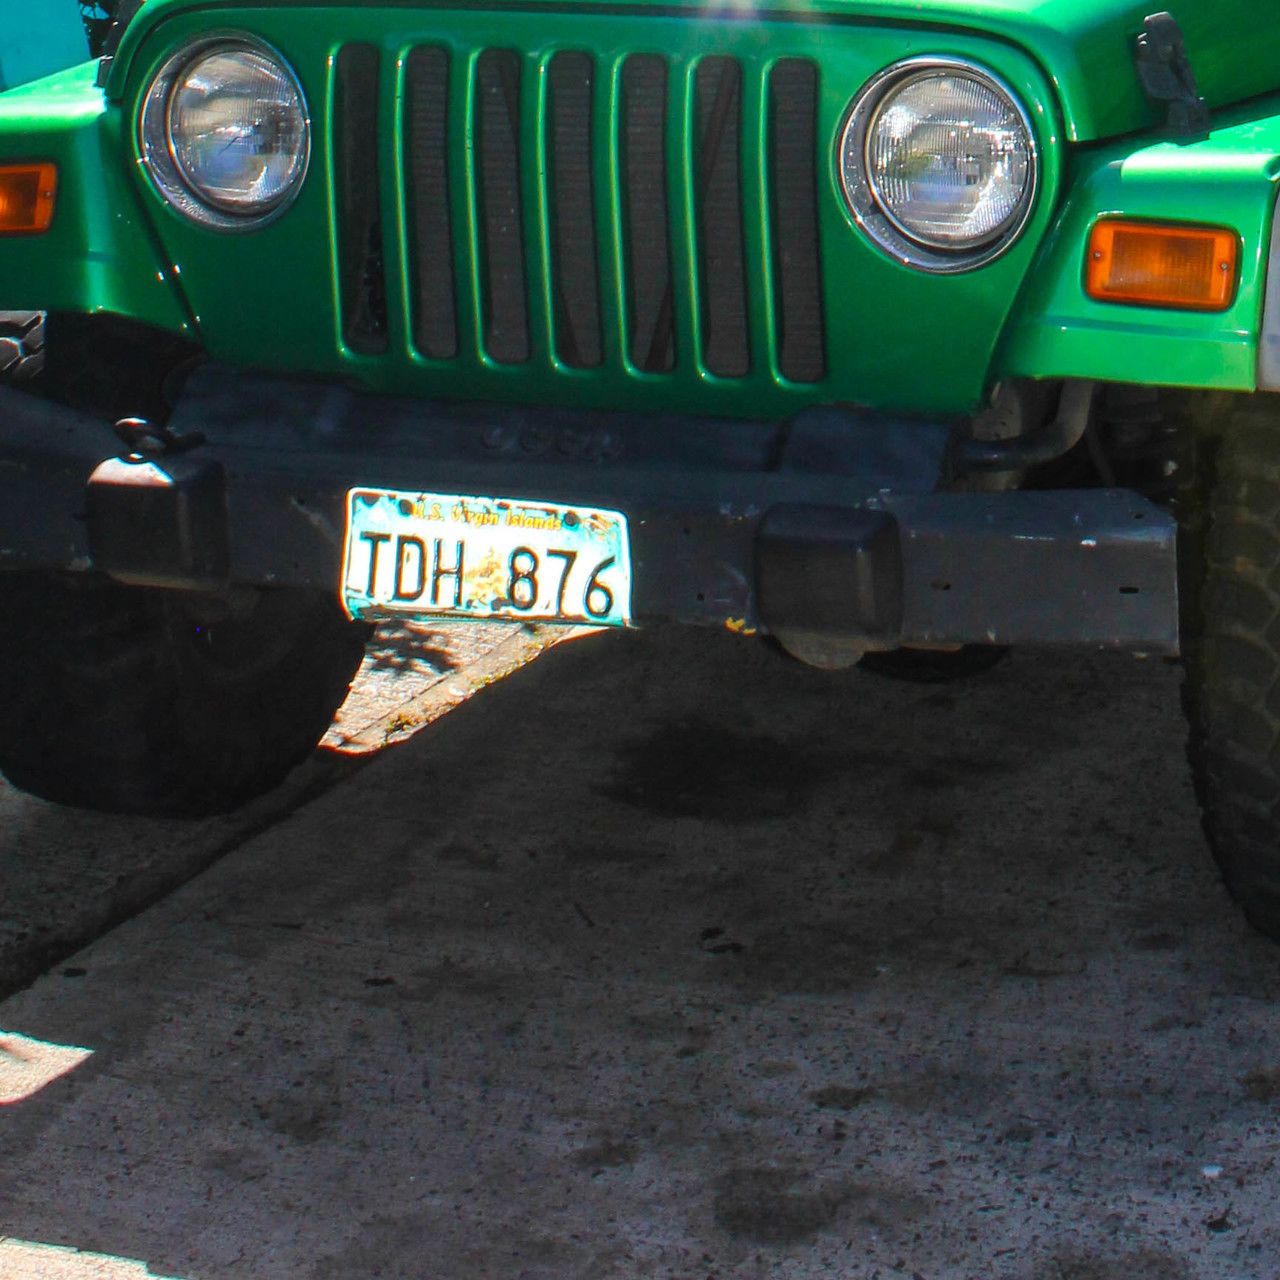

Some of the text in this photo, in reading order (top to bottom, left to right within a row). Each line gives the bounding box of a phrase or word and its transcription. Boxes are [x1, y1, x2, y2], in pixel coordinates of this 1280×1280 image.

[411, 501, 562, 531] U.S. Virgin Islands
[360, 530, 617, 619] TDH 876
